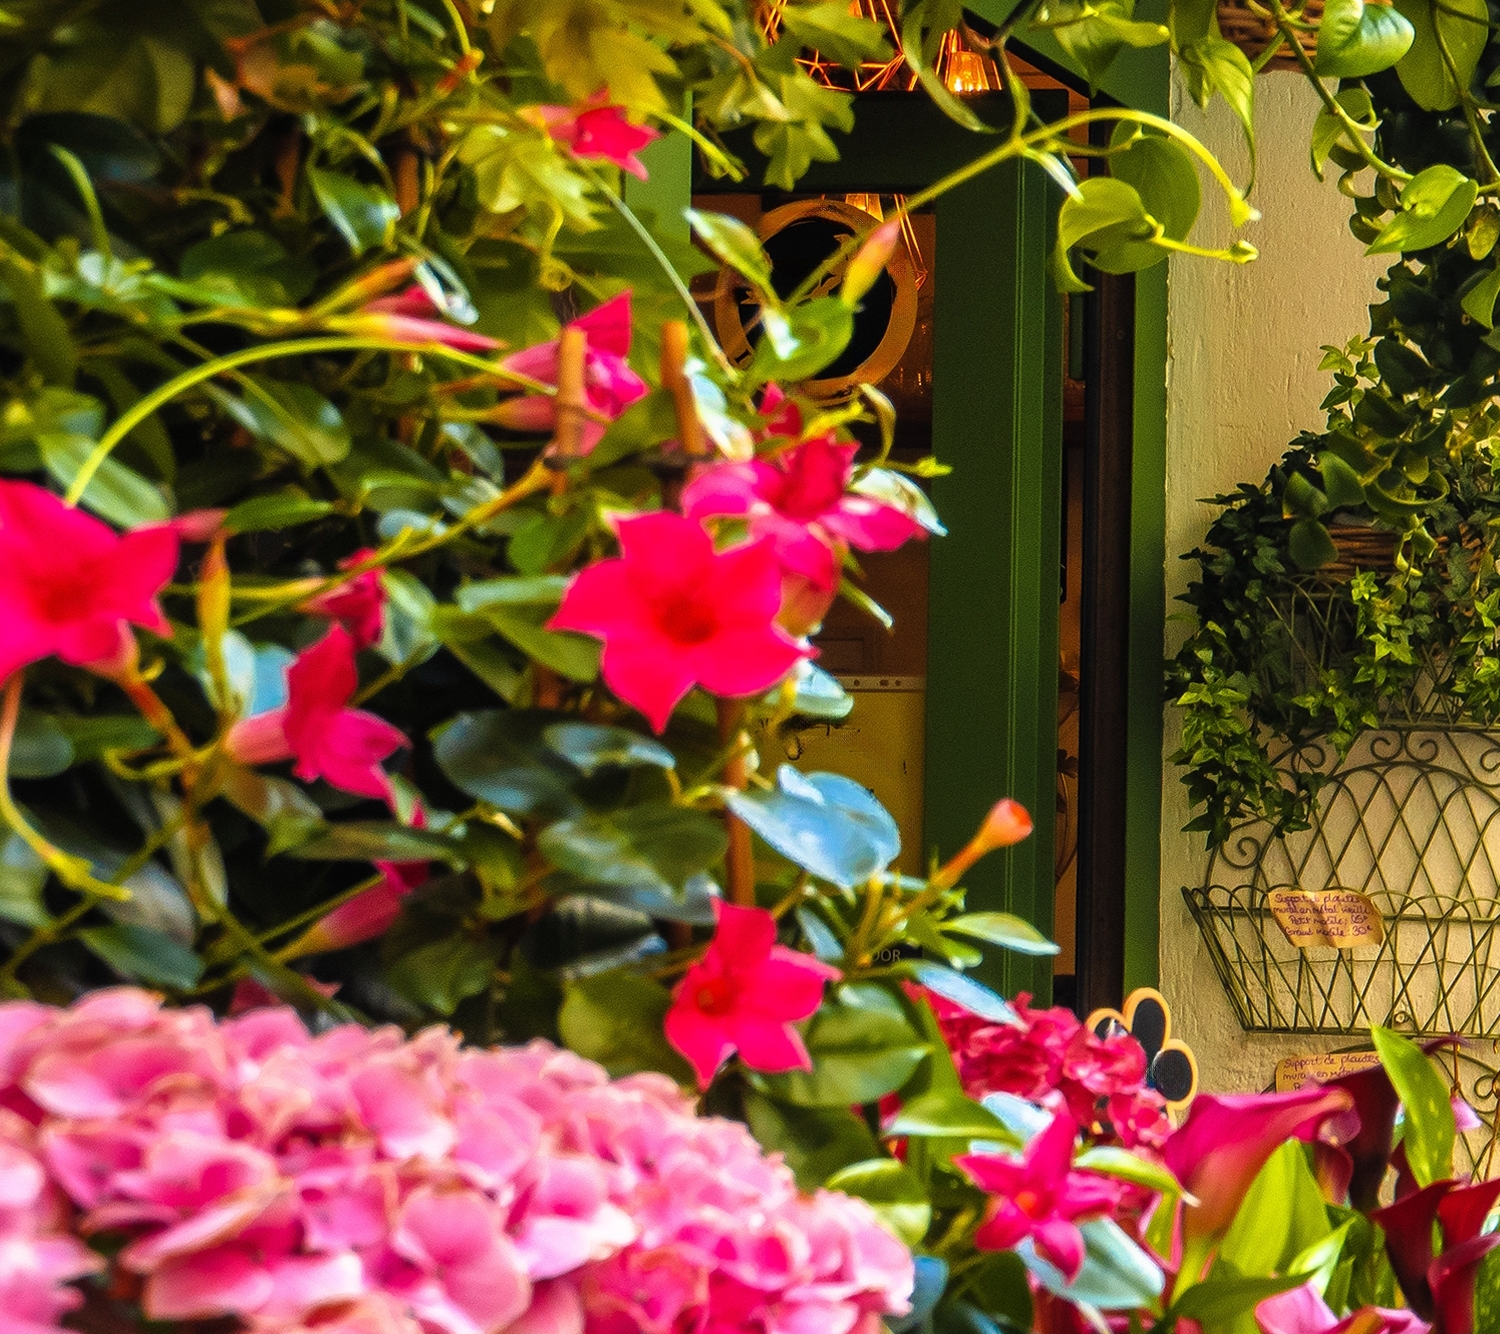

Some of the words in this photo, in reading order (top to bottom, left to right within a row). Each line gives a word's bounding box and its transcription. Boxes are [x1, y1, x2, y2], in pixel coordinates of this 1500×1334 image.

[1275, 893, 1308, 907] Support
[1283, 1056, 1321, 1071] Support
[1323, 1054, 1335, 1066] de
[1282, 1072, 1307, 1081] mura
[1316, 1070, 1328, 1078] en
